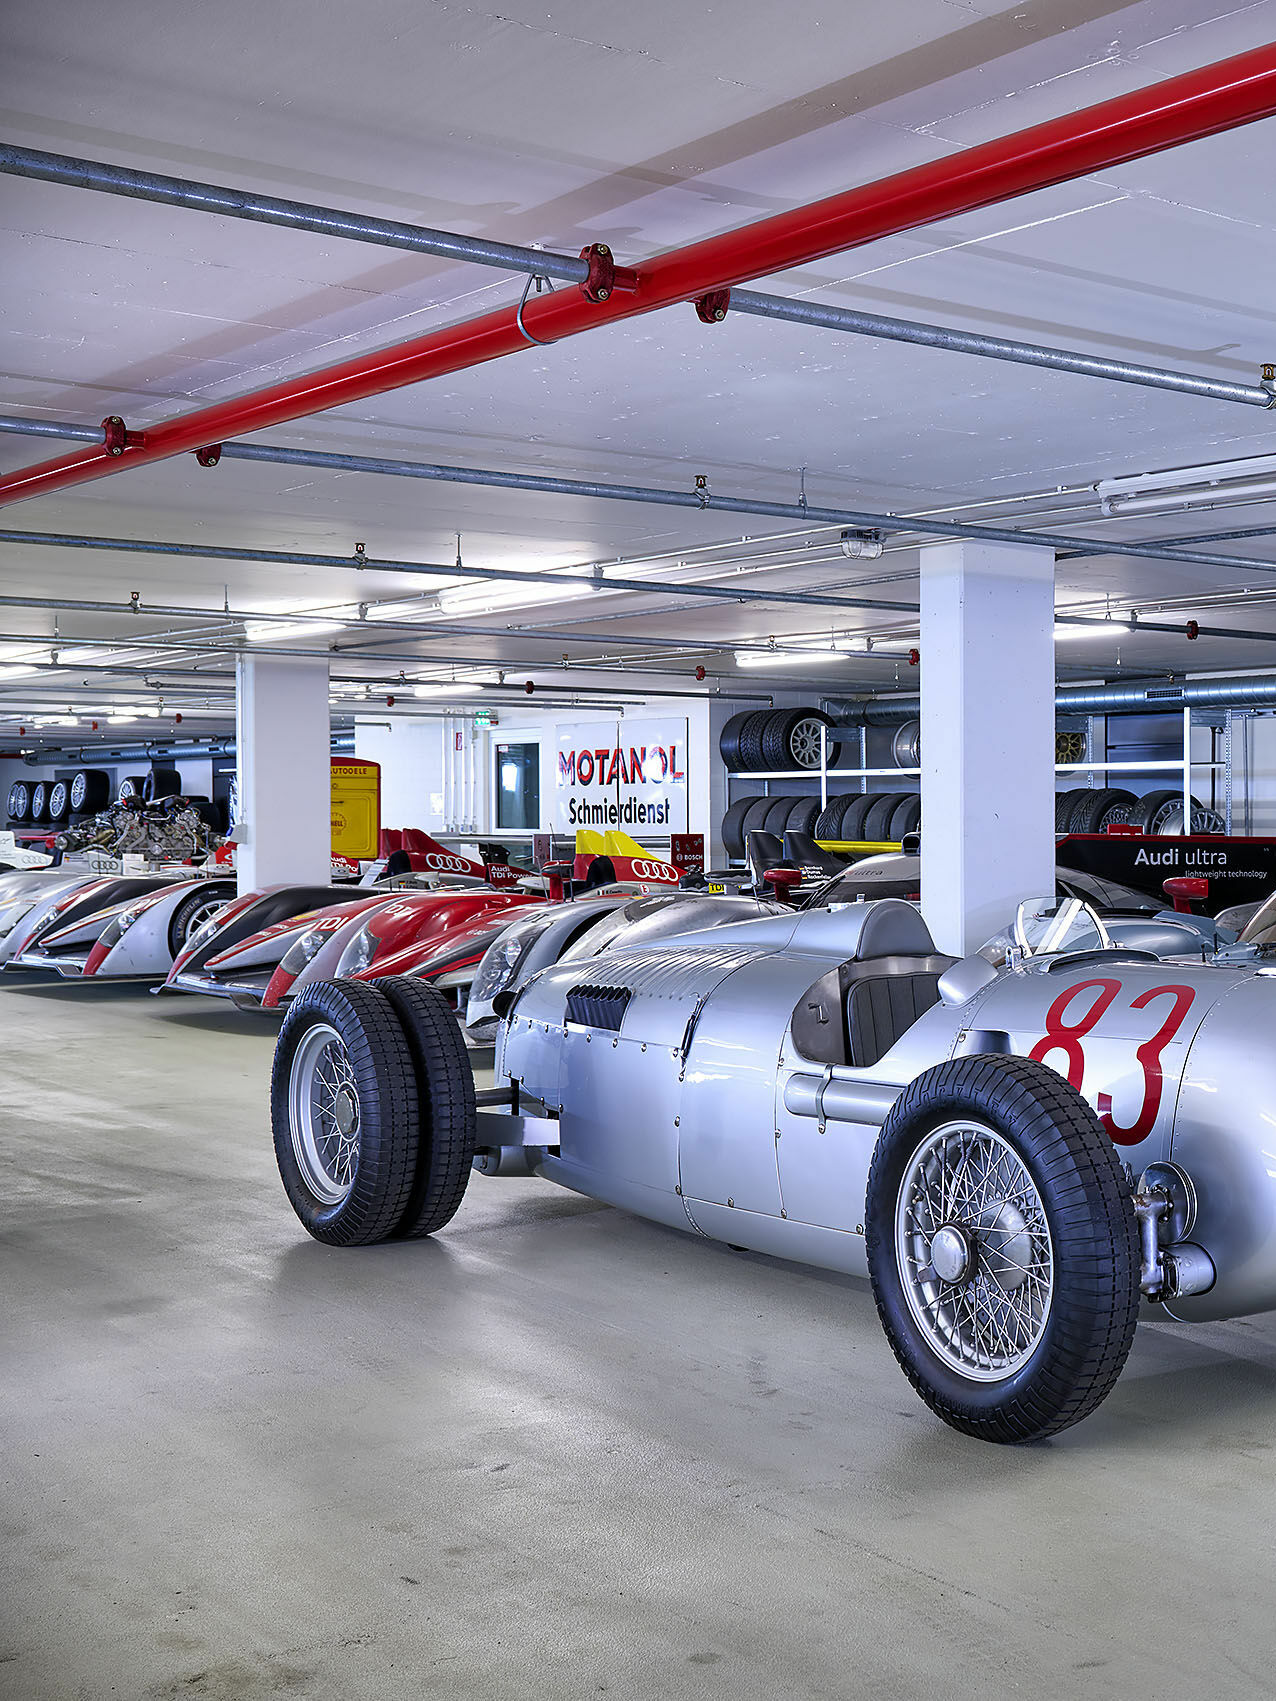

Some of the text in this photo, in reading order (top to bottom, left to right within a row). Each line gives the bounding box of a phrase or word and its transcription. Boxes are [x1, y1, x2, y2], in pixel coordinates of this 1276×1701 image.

[558, 746, 685, 786] MOTANOL
[568, 797, 670, 824] Schmierdienst
[1134, 848, 1227, 866] Audi ultra
[1185, 870, 1268, 879] lightweight technology
[312, 916, 349, 931] TDI
[1028, 978, 1196, 1146] 83
